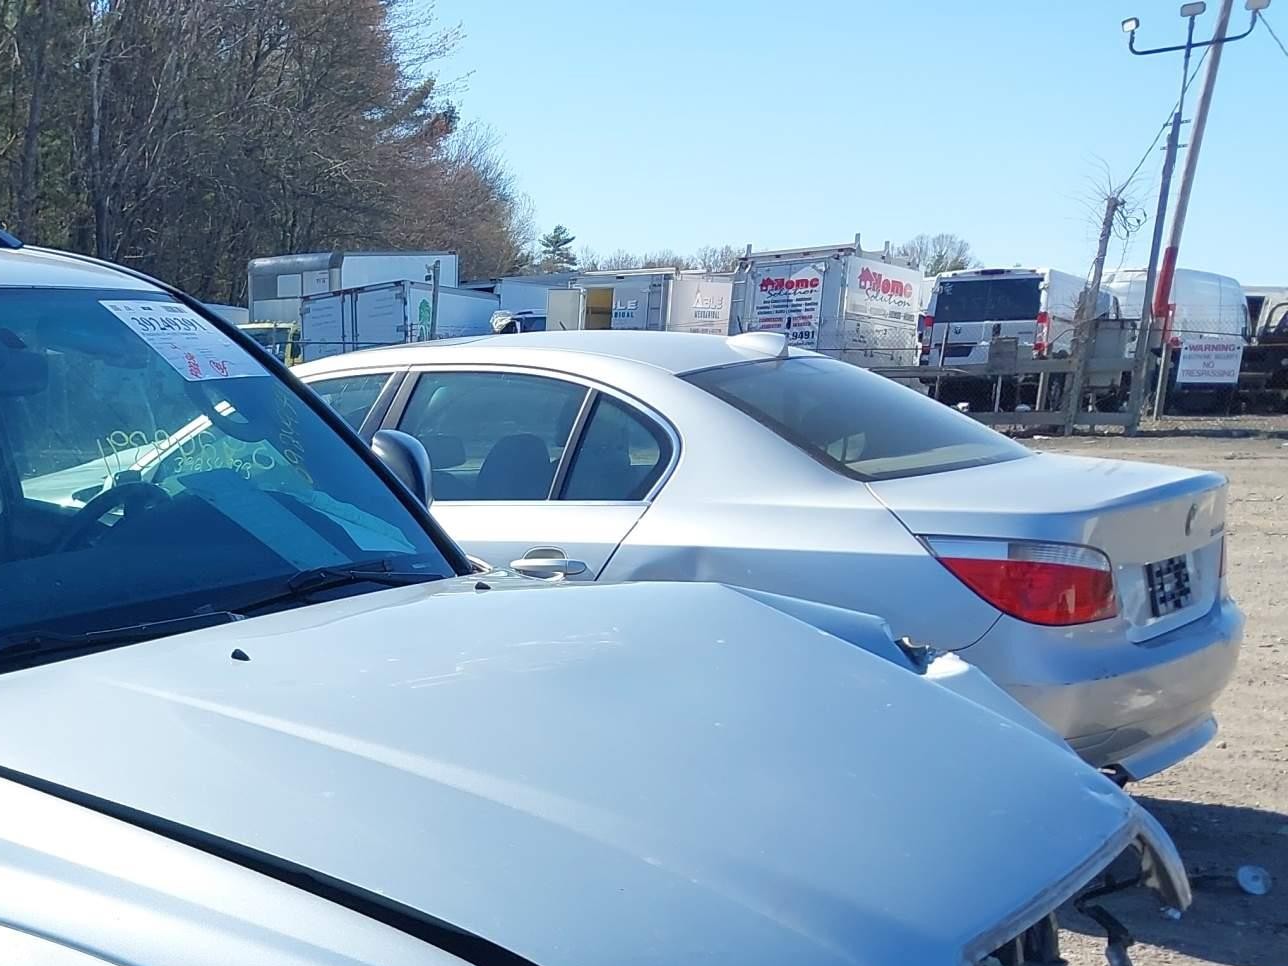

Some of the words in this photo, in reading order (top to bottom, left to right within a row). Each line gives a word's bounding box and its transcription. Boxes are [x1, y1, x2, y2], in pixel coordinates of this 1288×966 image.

[864, 288, 911, 307] Solution
[131, 316, 207, 332] 39249391
[1188, 343, 1236, 352] WARNING
[1202, 360, 1215, 369] NO
